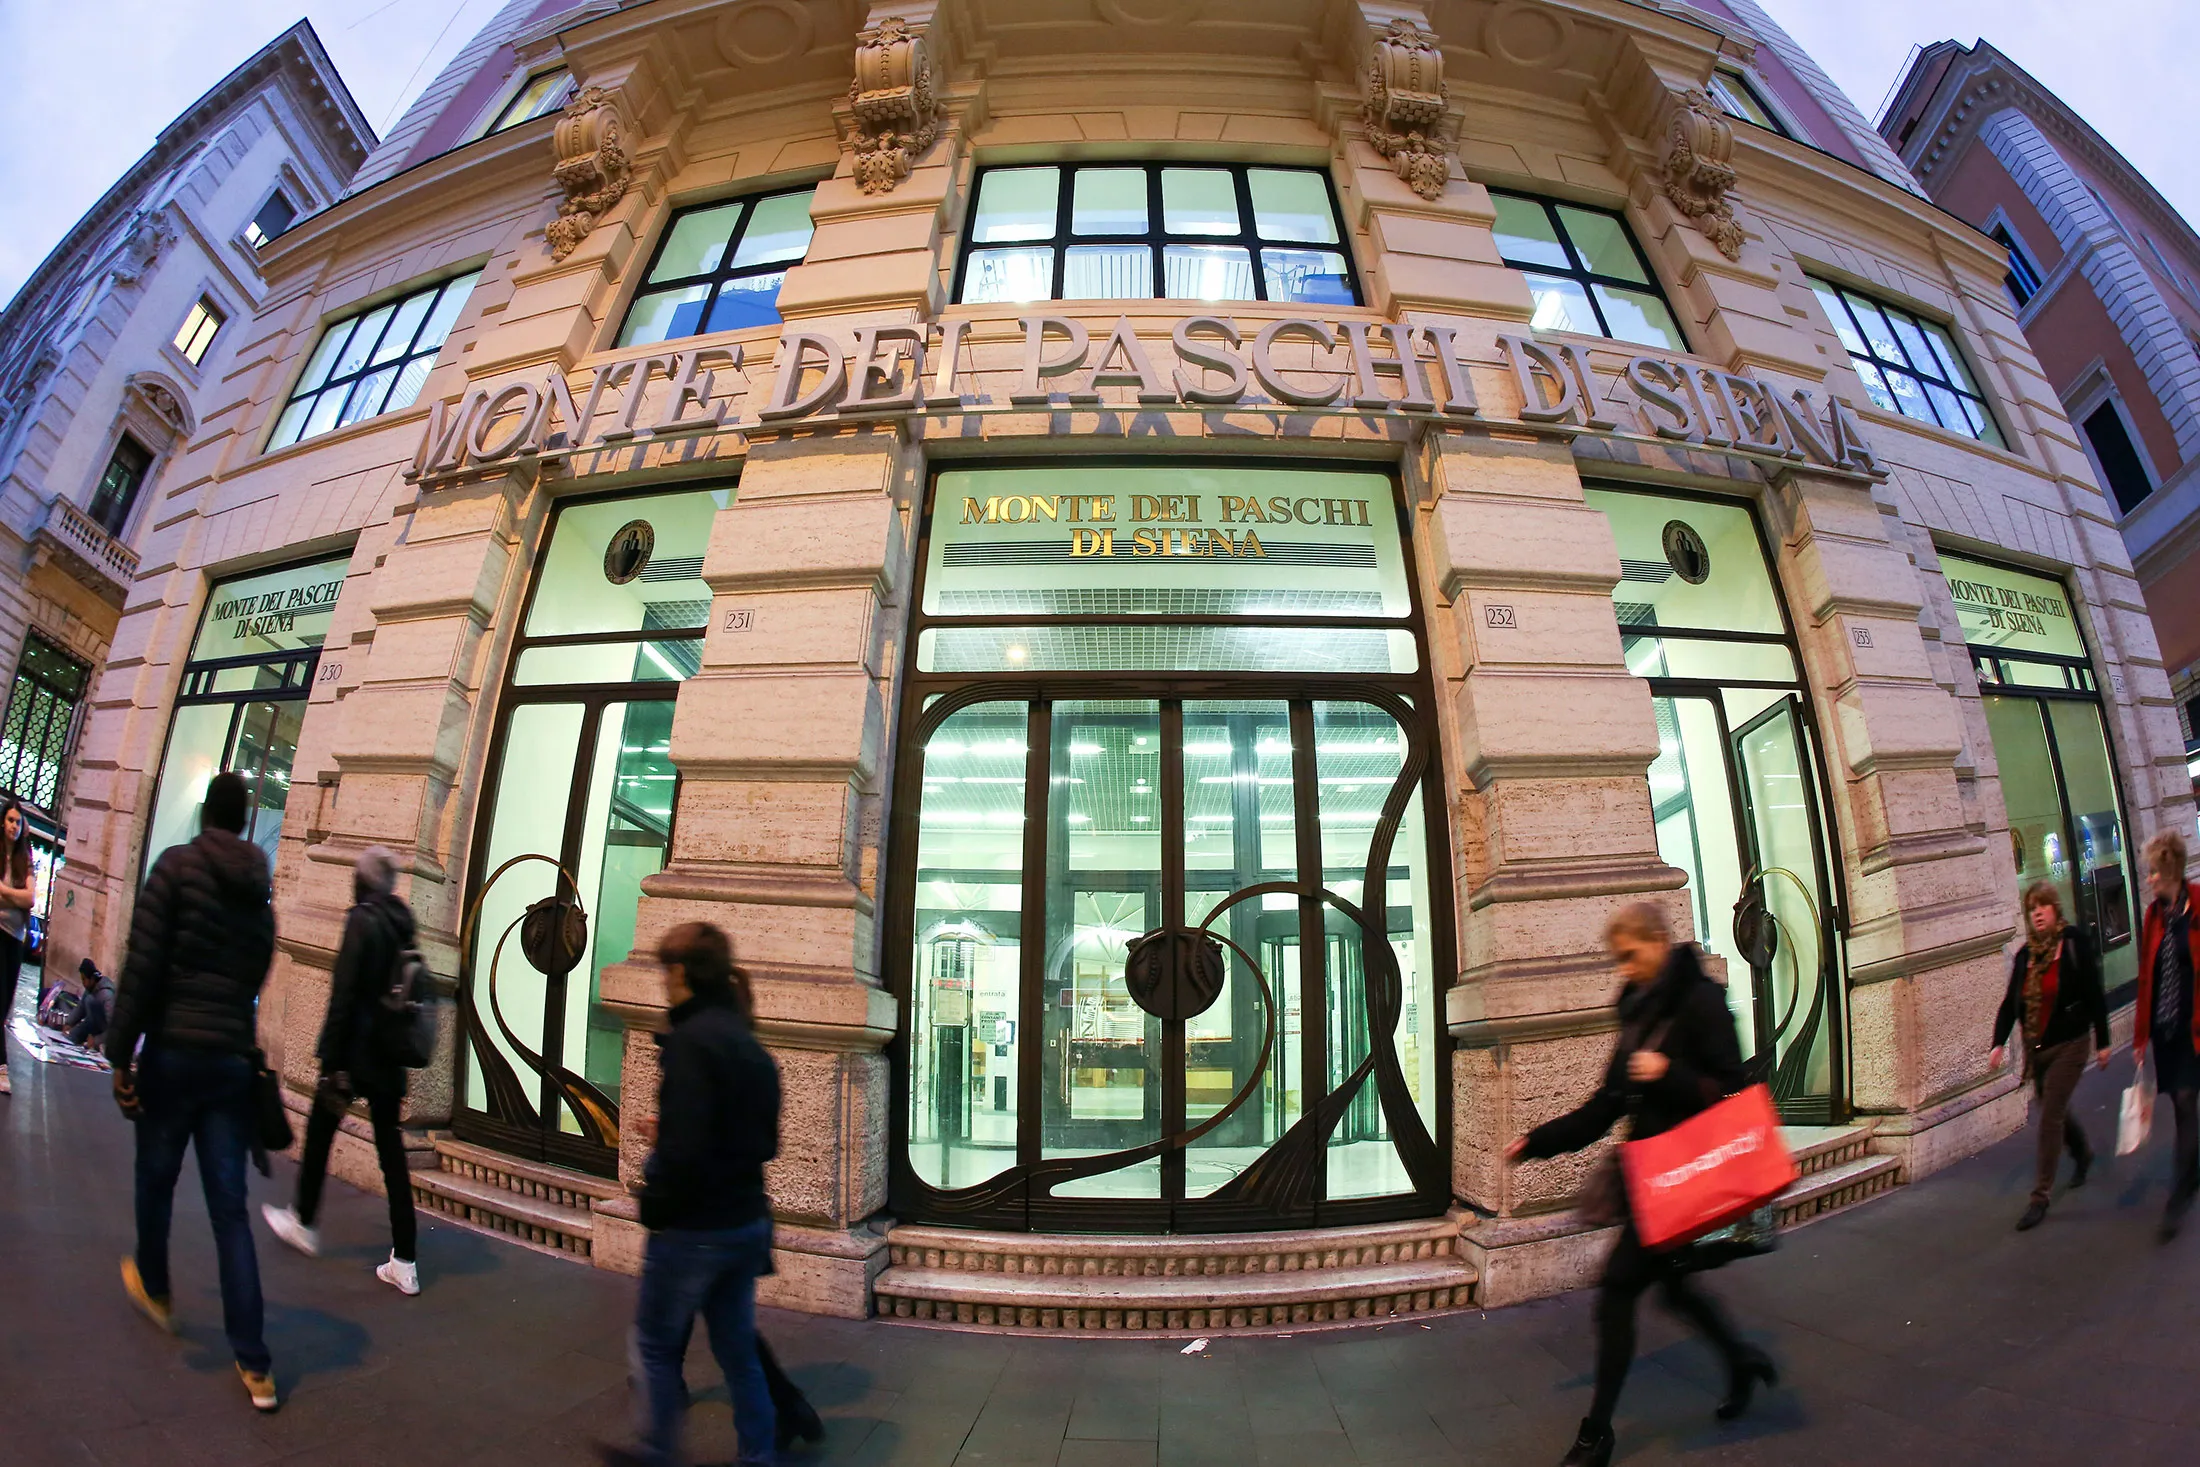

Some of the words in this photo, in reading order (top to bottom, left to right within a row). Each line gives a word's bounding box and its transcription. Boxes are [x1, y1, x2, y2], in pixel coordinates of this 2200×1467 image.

[412, 344, 743, 475] MONTE
[758, 318, 971, 420] DEI
[1008, 313, 1478, 416] PASCHI
[1495, 333, 1617, 430] DI
[1625, 356, 1890, 477] SIENA
[960, 495, 1117, 525] MONTE
[1128, 495, 1202, 522] DEI
[1218, 495, 1374, 527] PASCHI
[1068, 527, 1118, 557] DI
[1132, 528, 1269, 558] SIENA
[211, 596, 259, 621] MONTE
[257, 590, 286, 613] DEI
[1996, 587, 2023, 611] DEI
[2022, 592, 2066, 618] PASCHI
[233, 618, 250, 639] DI
[251, 612, 295, 636] SIENA
[726, 612, 750, 629] 231
[1488, 608, 1513, 625] 232
[1989, 609, 2007, 630] DI
[2006, 611, 2047, 636] SIENA
[1855, 630, 1871, 645] 233
[320, 663, 343, 681] 230
